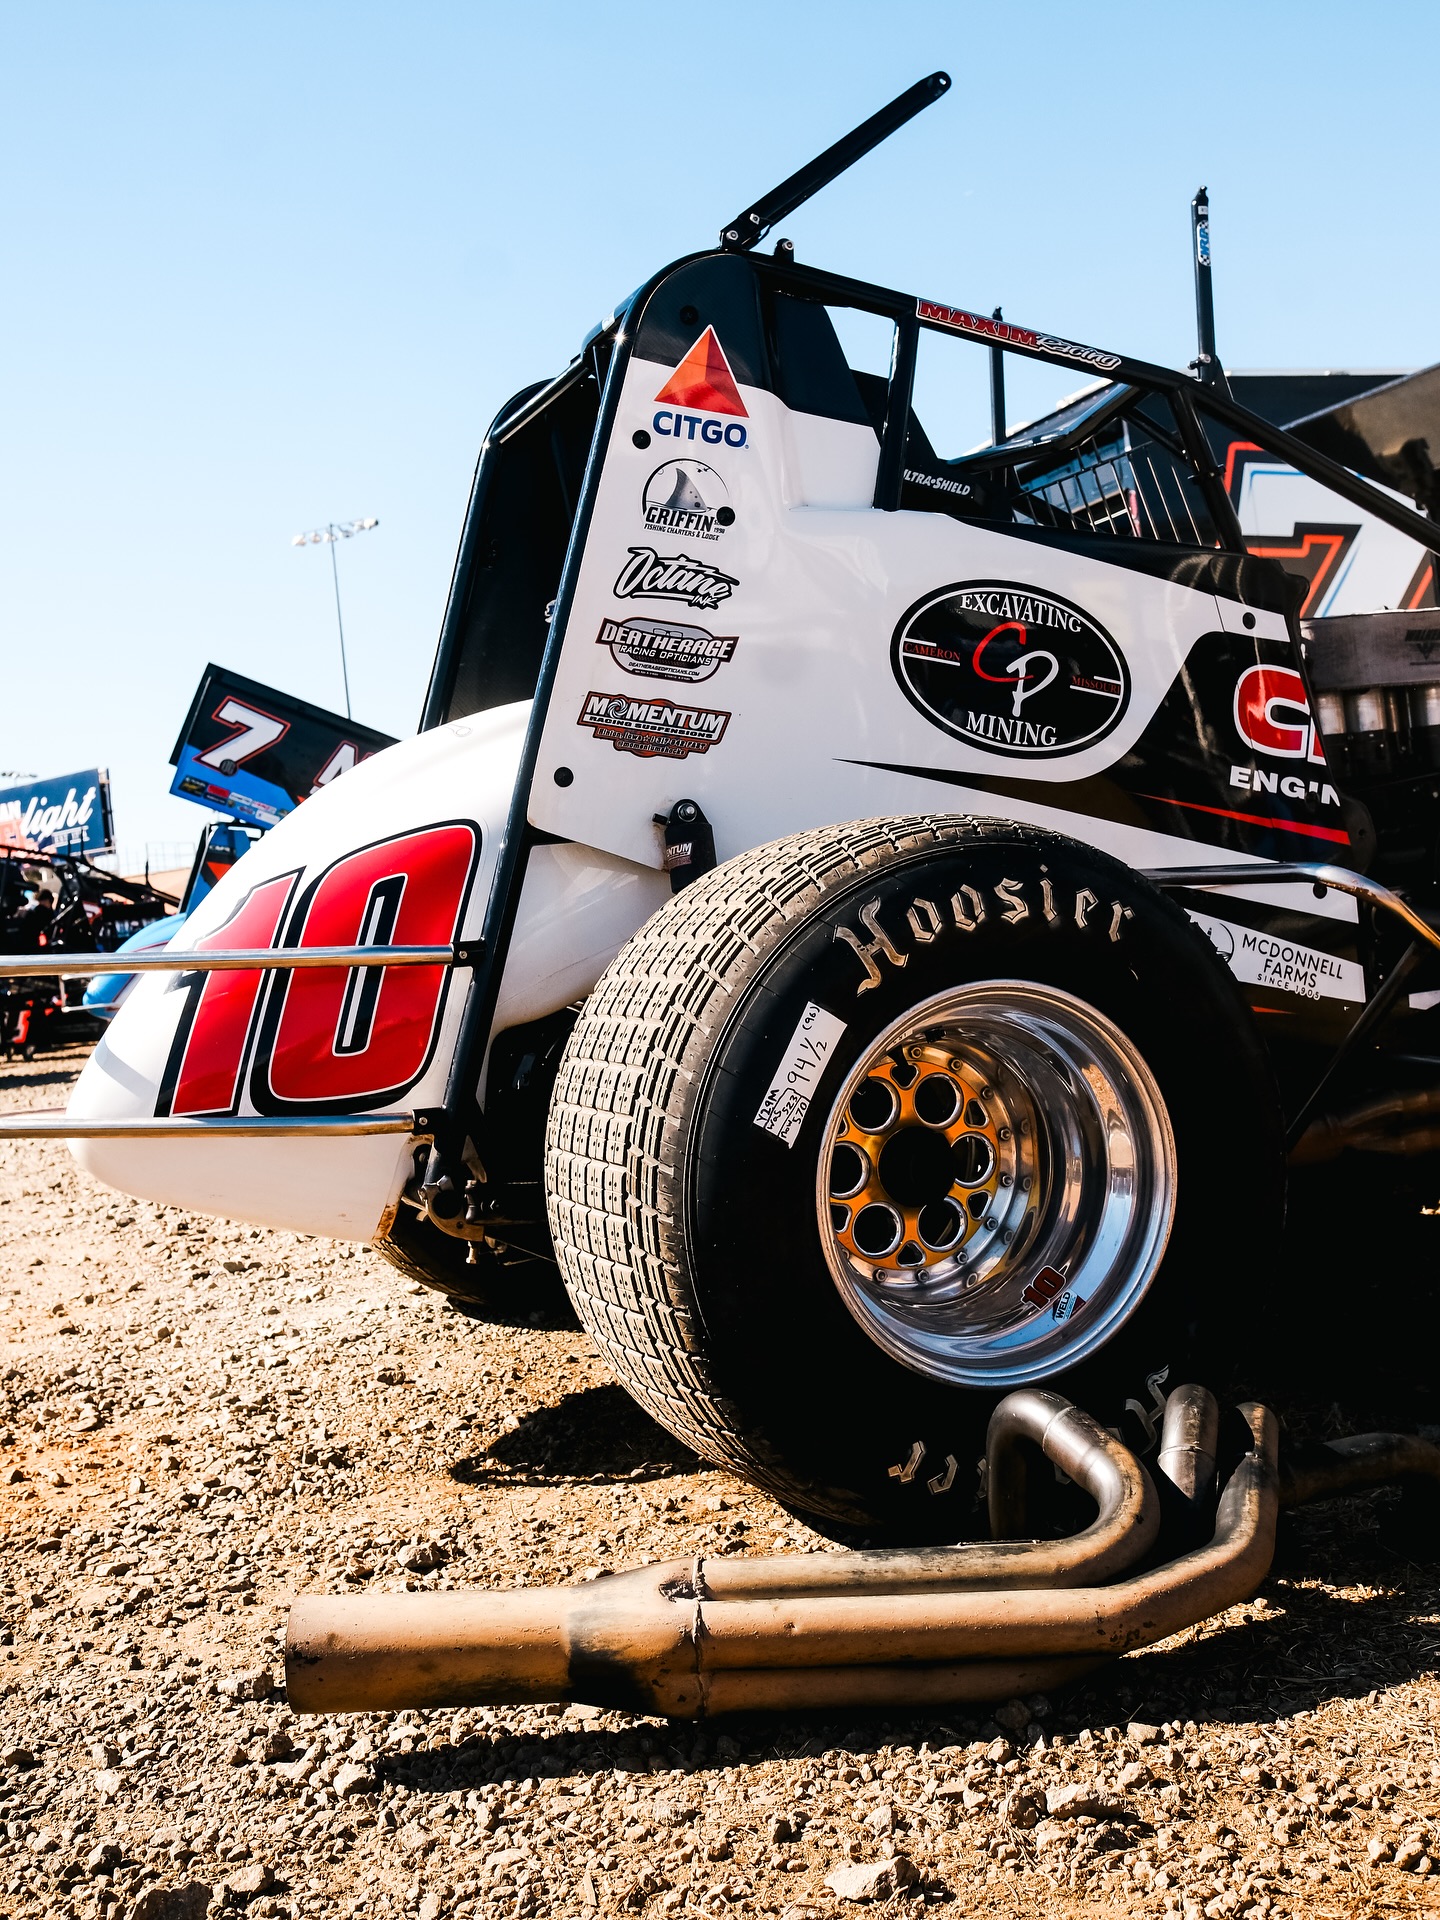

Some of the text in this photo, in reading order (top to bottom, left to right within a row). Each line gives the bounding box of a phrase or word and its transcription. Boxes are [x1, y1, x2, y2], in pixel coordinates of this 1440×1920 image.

[918, 301, 1119, 367] MAXIM Racing
[652, 410, 748, 448] CITGO
[643, 523, 667, 533] FISHING
[666, 526, 696, 538] CHARTERS
[695, 530, 701, 538] &
[645, 506, 715, 532] GRIFFIN
[612, 546, 741, 600] Octane
[690, 595, 719, 609] INK
[960, 593, 1082, 633] EXCAVATING
[601, 622, 734, 659] DEATHERAGE
[619, 644, 712, 666] RACING OPTICIANS
[903, 642, 961, 662] CAMERON
[1071, 675, 1121, 695] MISSOURI
[585, 695, 727, 733] MOMENTUM
[588, 715, 714, 739] RACING SUSPENSIONS
[965, 710, 1057, 746] MINING
[191, 695, 291, 776] 7
[20, 786, 97, 844] light
[834, 864, 1136, 998] Hoosier
[152, 817, 483, 1118] 10
[1241, 933, 1344, 980] MCDONNELL
[1263, 958, 1318, 989] FARMS
[1256, 973, 1321, 1000] SINCE 1905
[1020, 1264, 1067, 1312] 10
[1055, 1291, 1072, 1319] WELD
